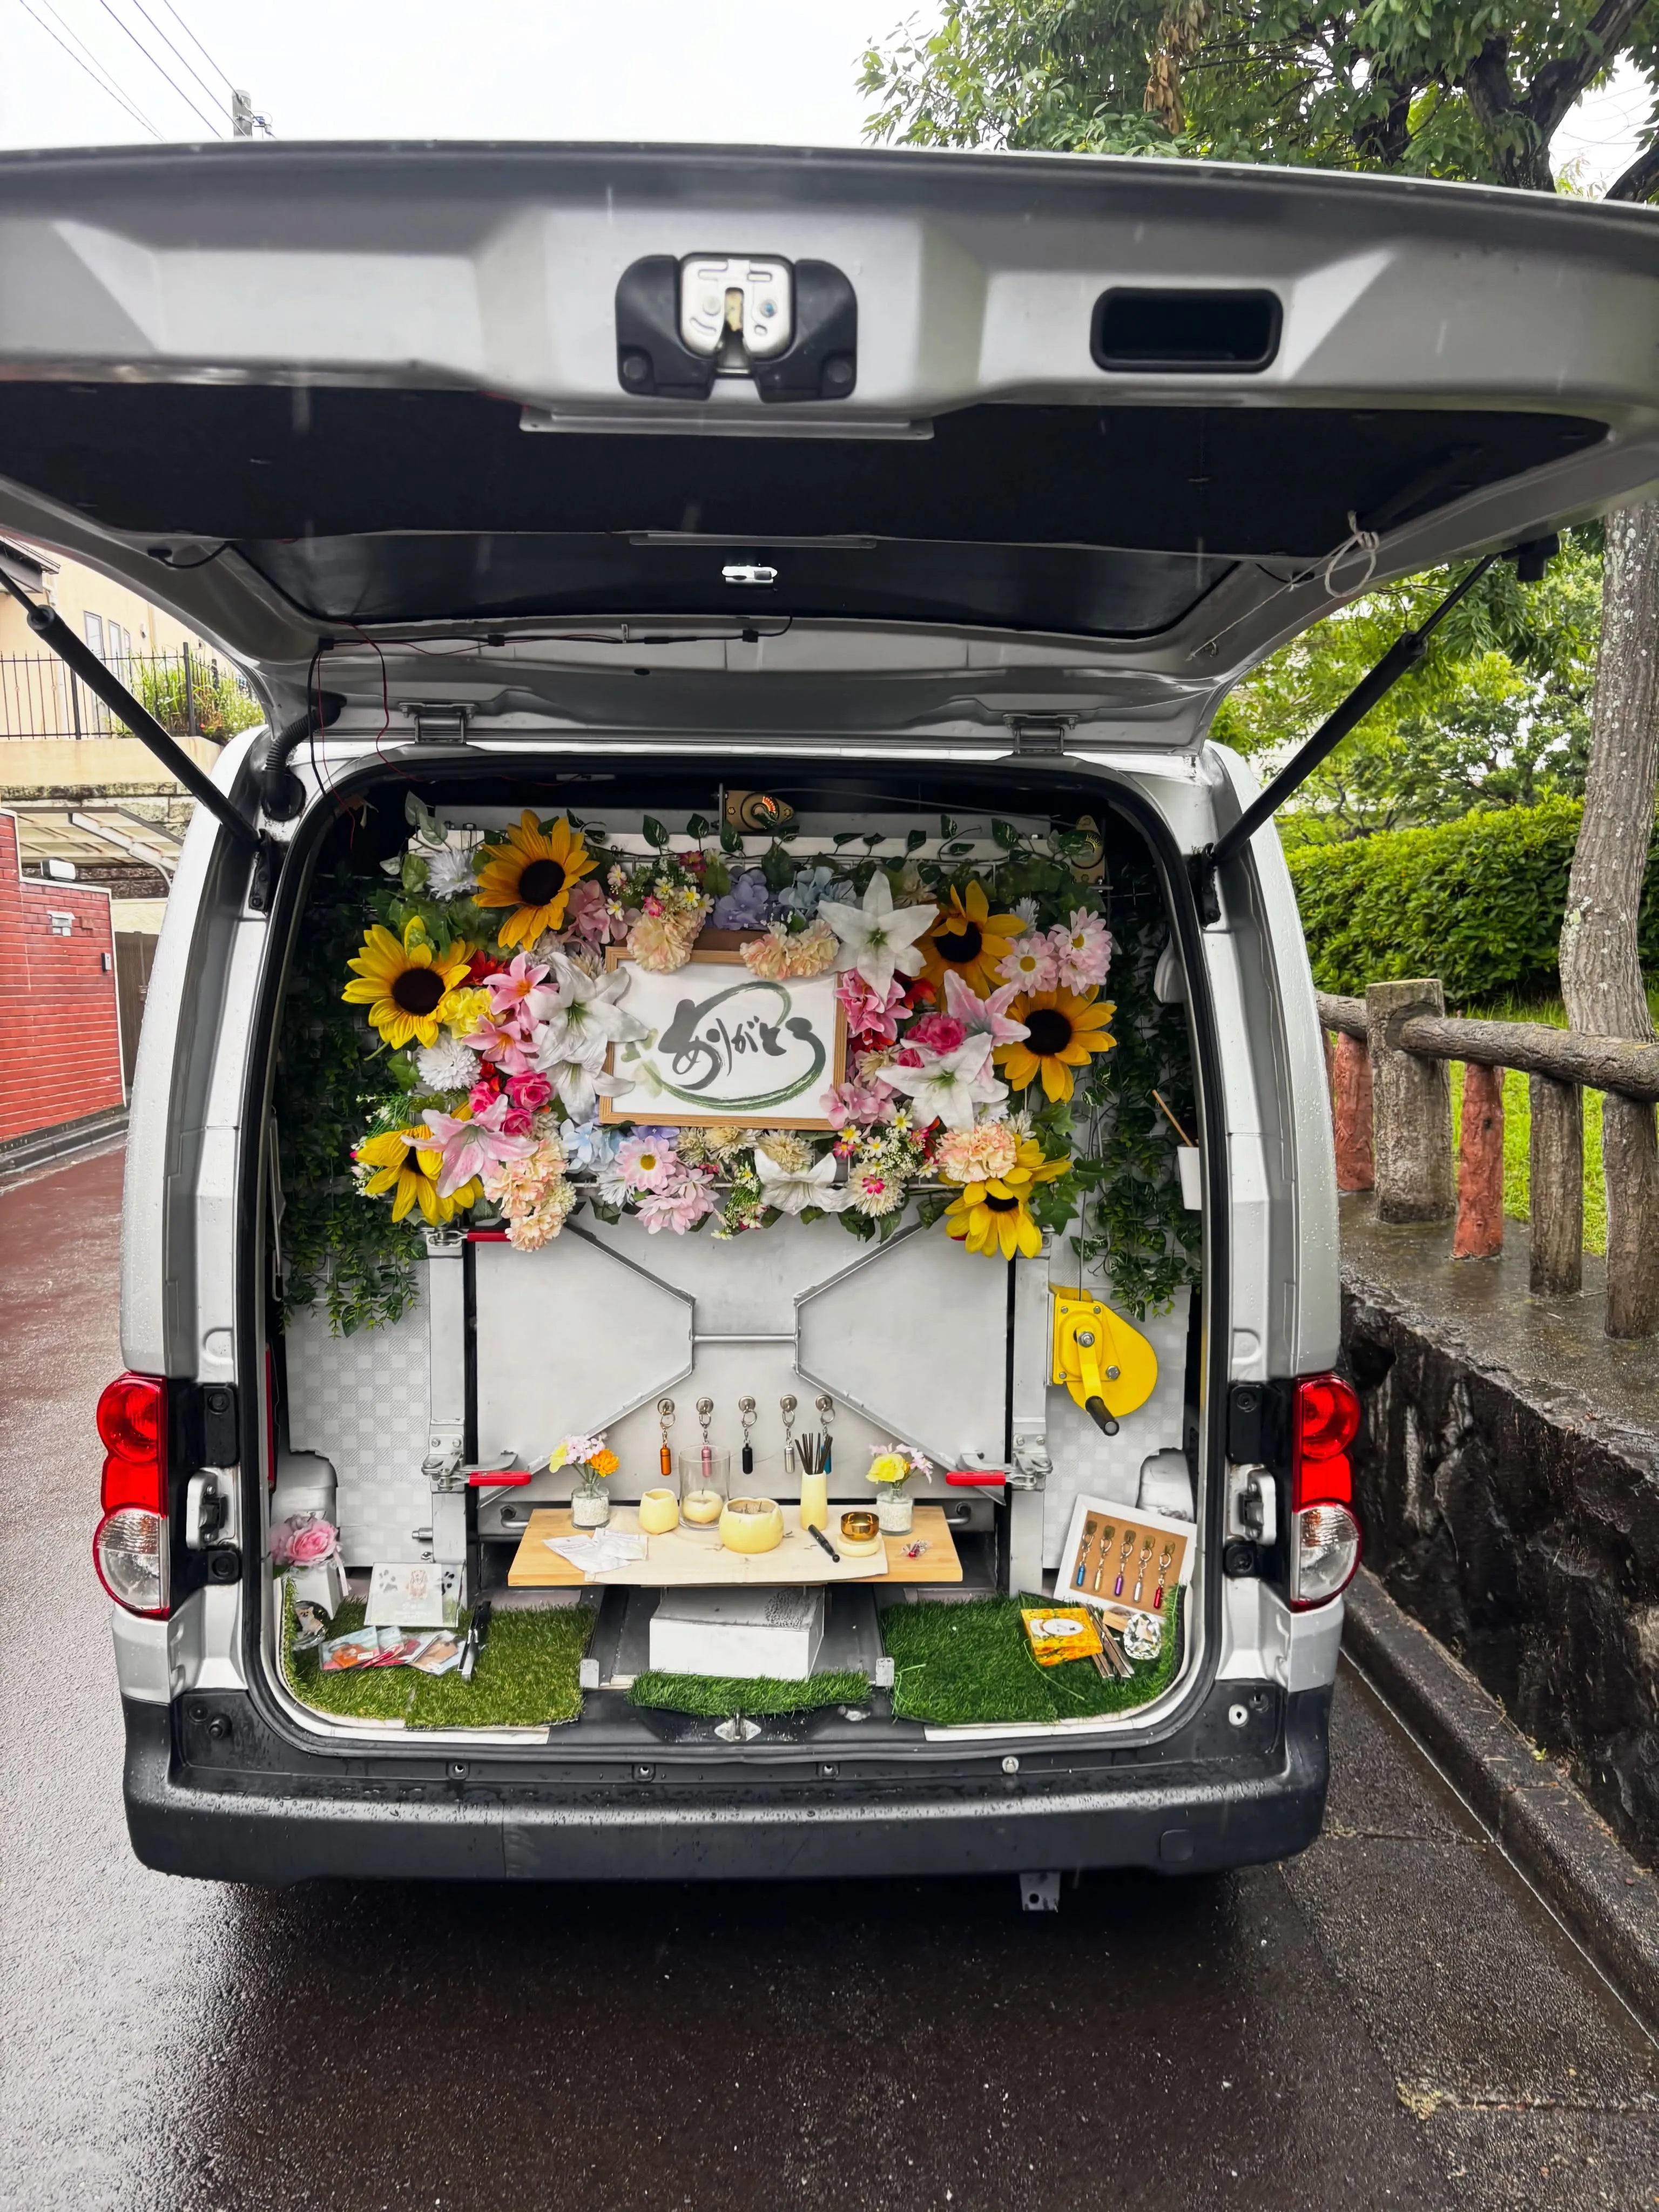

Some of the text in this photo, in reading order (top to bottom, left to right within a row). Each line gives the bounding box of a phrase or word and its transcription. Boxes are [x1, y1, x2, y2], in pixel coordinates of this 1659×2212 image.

[643, 981, 826, 1111] ありがとう
